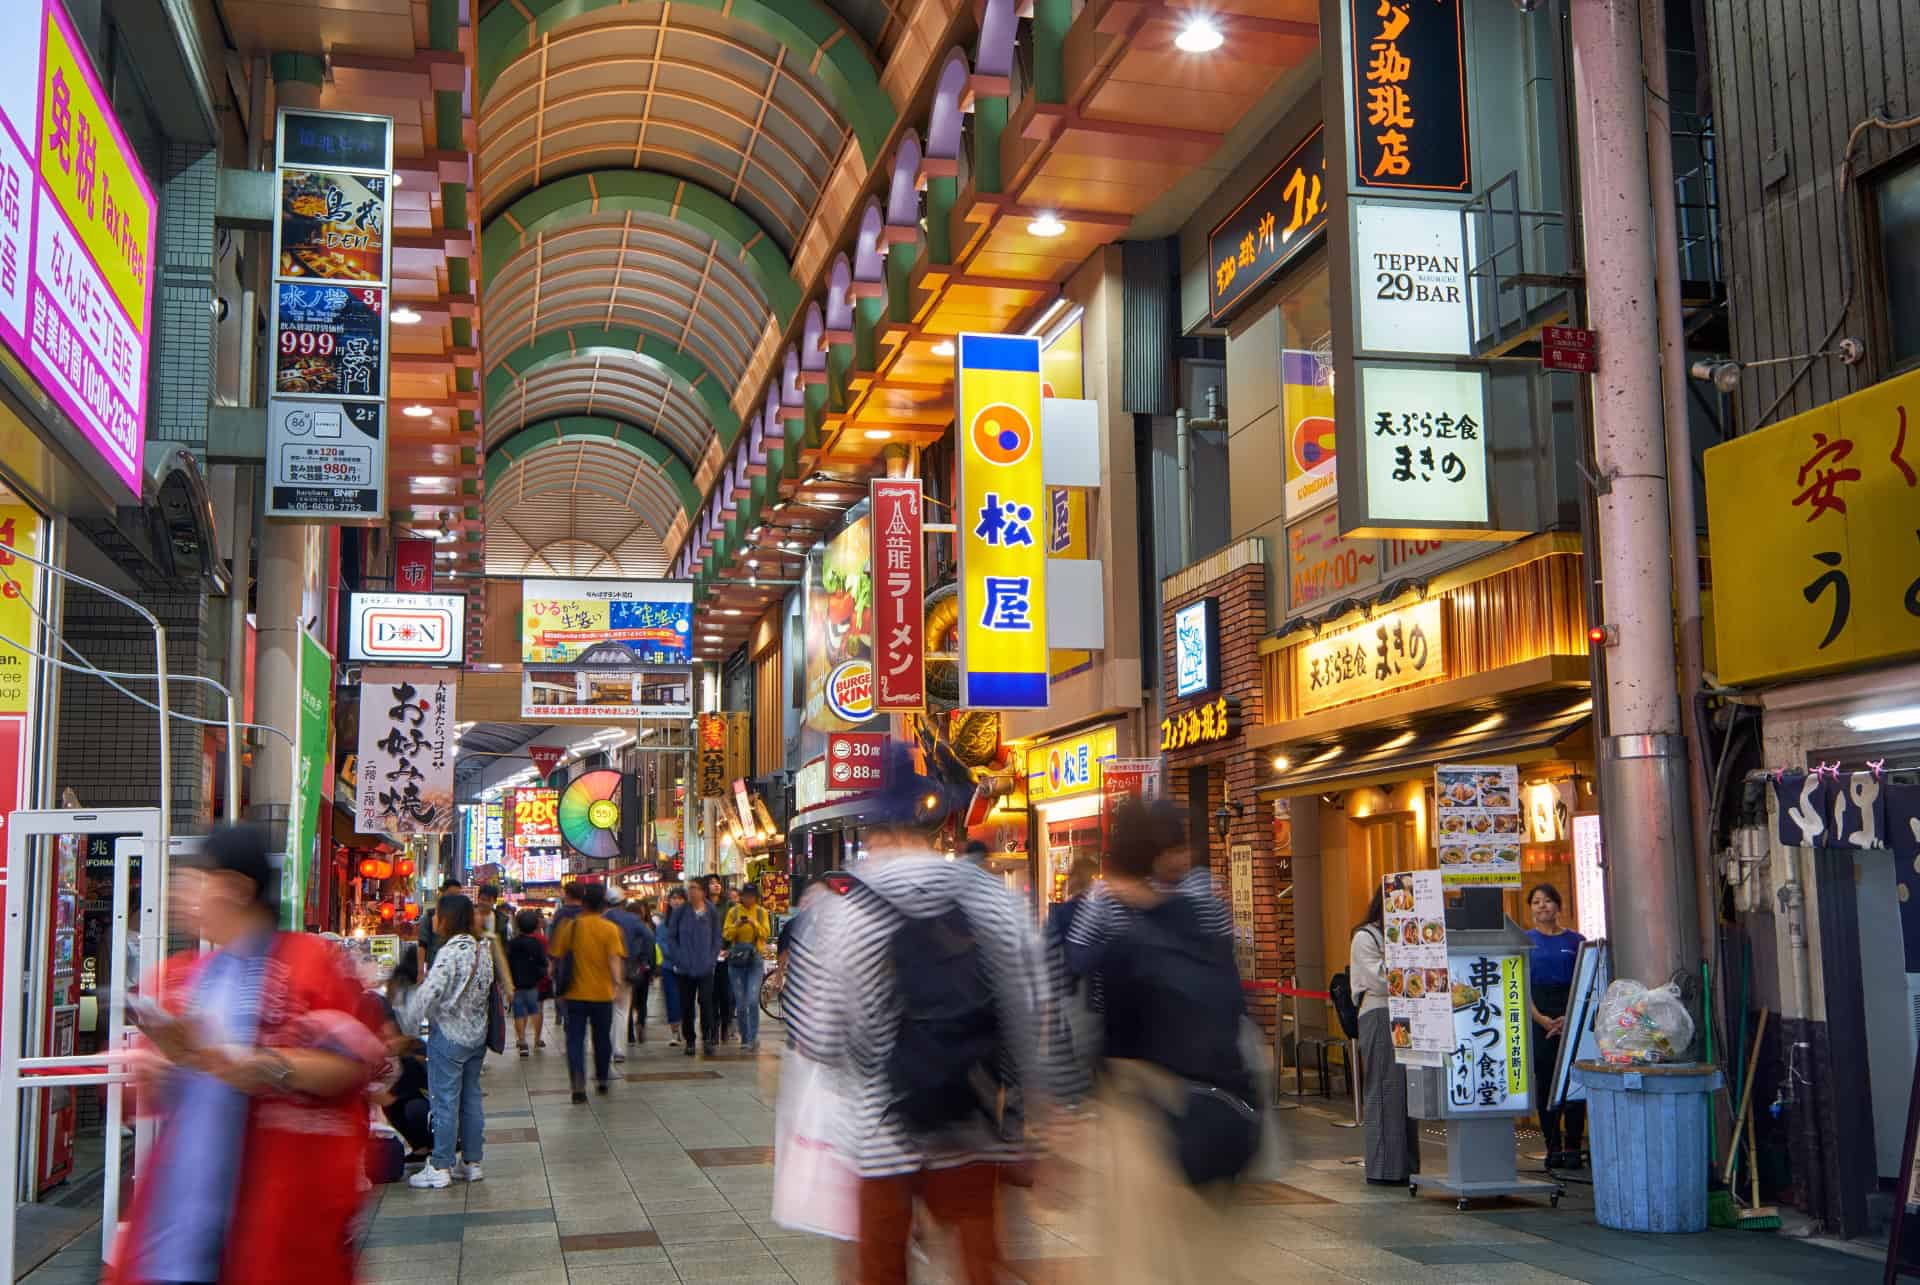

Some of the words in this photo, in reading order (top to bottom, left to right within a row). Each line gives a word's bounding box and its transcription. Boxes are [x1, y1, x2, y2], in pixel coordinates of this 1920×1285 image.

[50, 66, 96, 221] 免税
[367, 179, 384, 192] 4F
[102, 174, 120, 241] Tax
[121, 211, 145, 288] Free
[1215, 212, 1276, 297] 珈琲所
[1374, 252, 1460, 273] TEPPAN
[50, 230, 135, 396] なんば三丁目店
[1377, 272, 1414, 301] 29
[1416, 285, 1461, 303] BAR
[34, 286, 82, 390] 営業時間
[82, 355, 138, 458] 10:00-23:30
[356, 408, 377, 421] 2F
[1375, 411, 1479, 440] 天ぷら定食
[1392, 445, 1467, 483] まきの
[884, 500, 914, 676] 金龍ラーメン
[974, 491, 1034, 633] 松屋
[836, 673, 871, 693] BURGE
[1310, 643, 1367, 691] 天ぷら定食
[1375, 617, 1428, 681] まきの
[838, 683, 872, 707] KIN
[377, 681, 437, 825] お好み焼
[1064, 744, 1089, 786] 松屋
[1468, 956, 1502, 1107] 串かつ食堂
